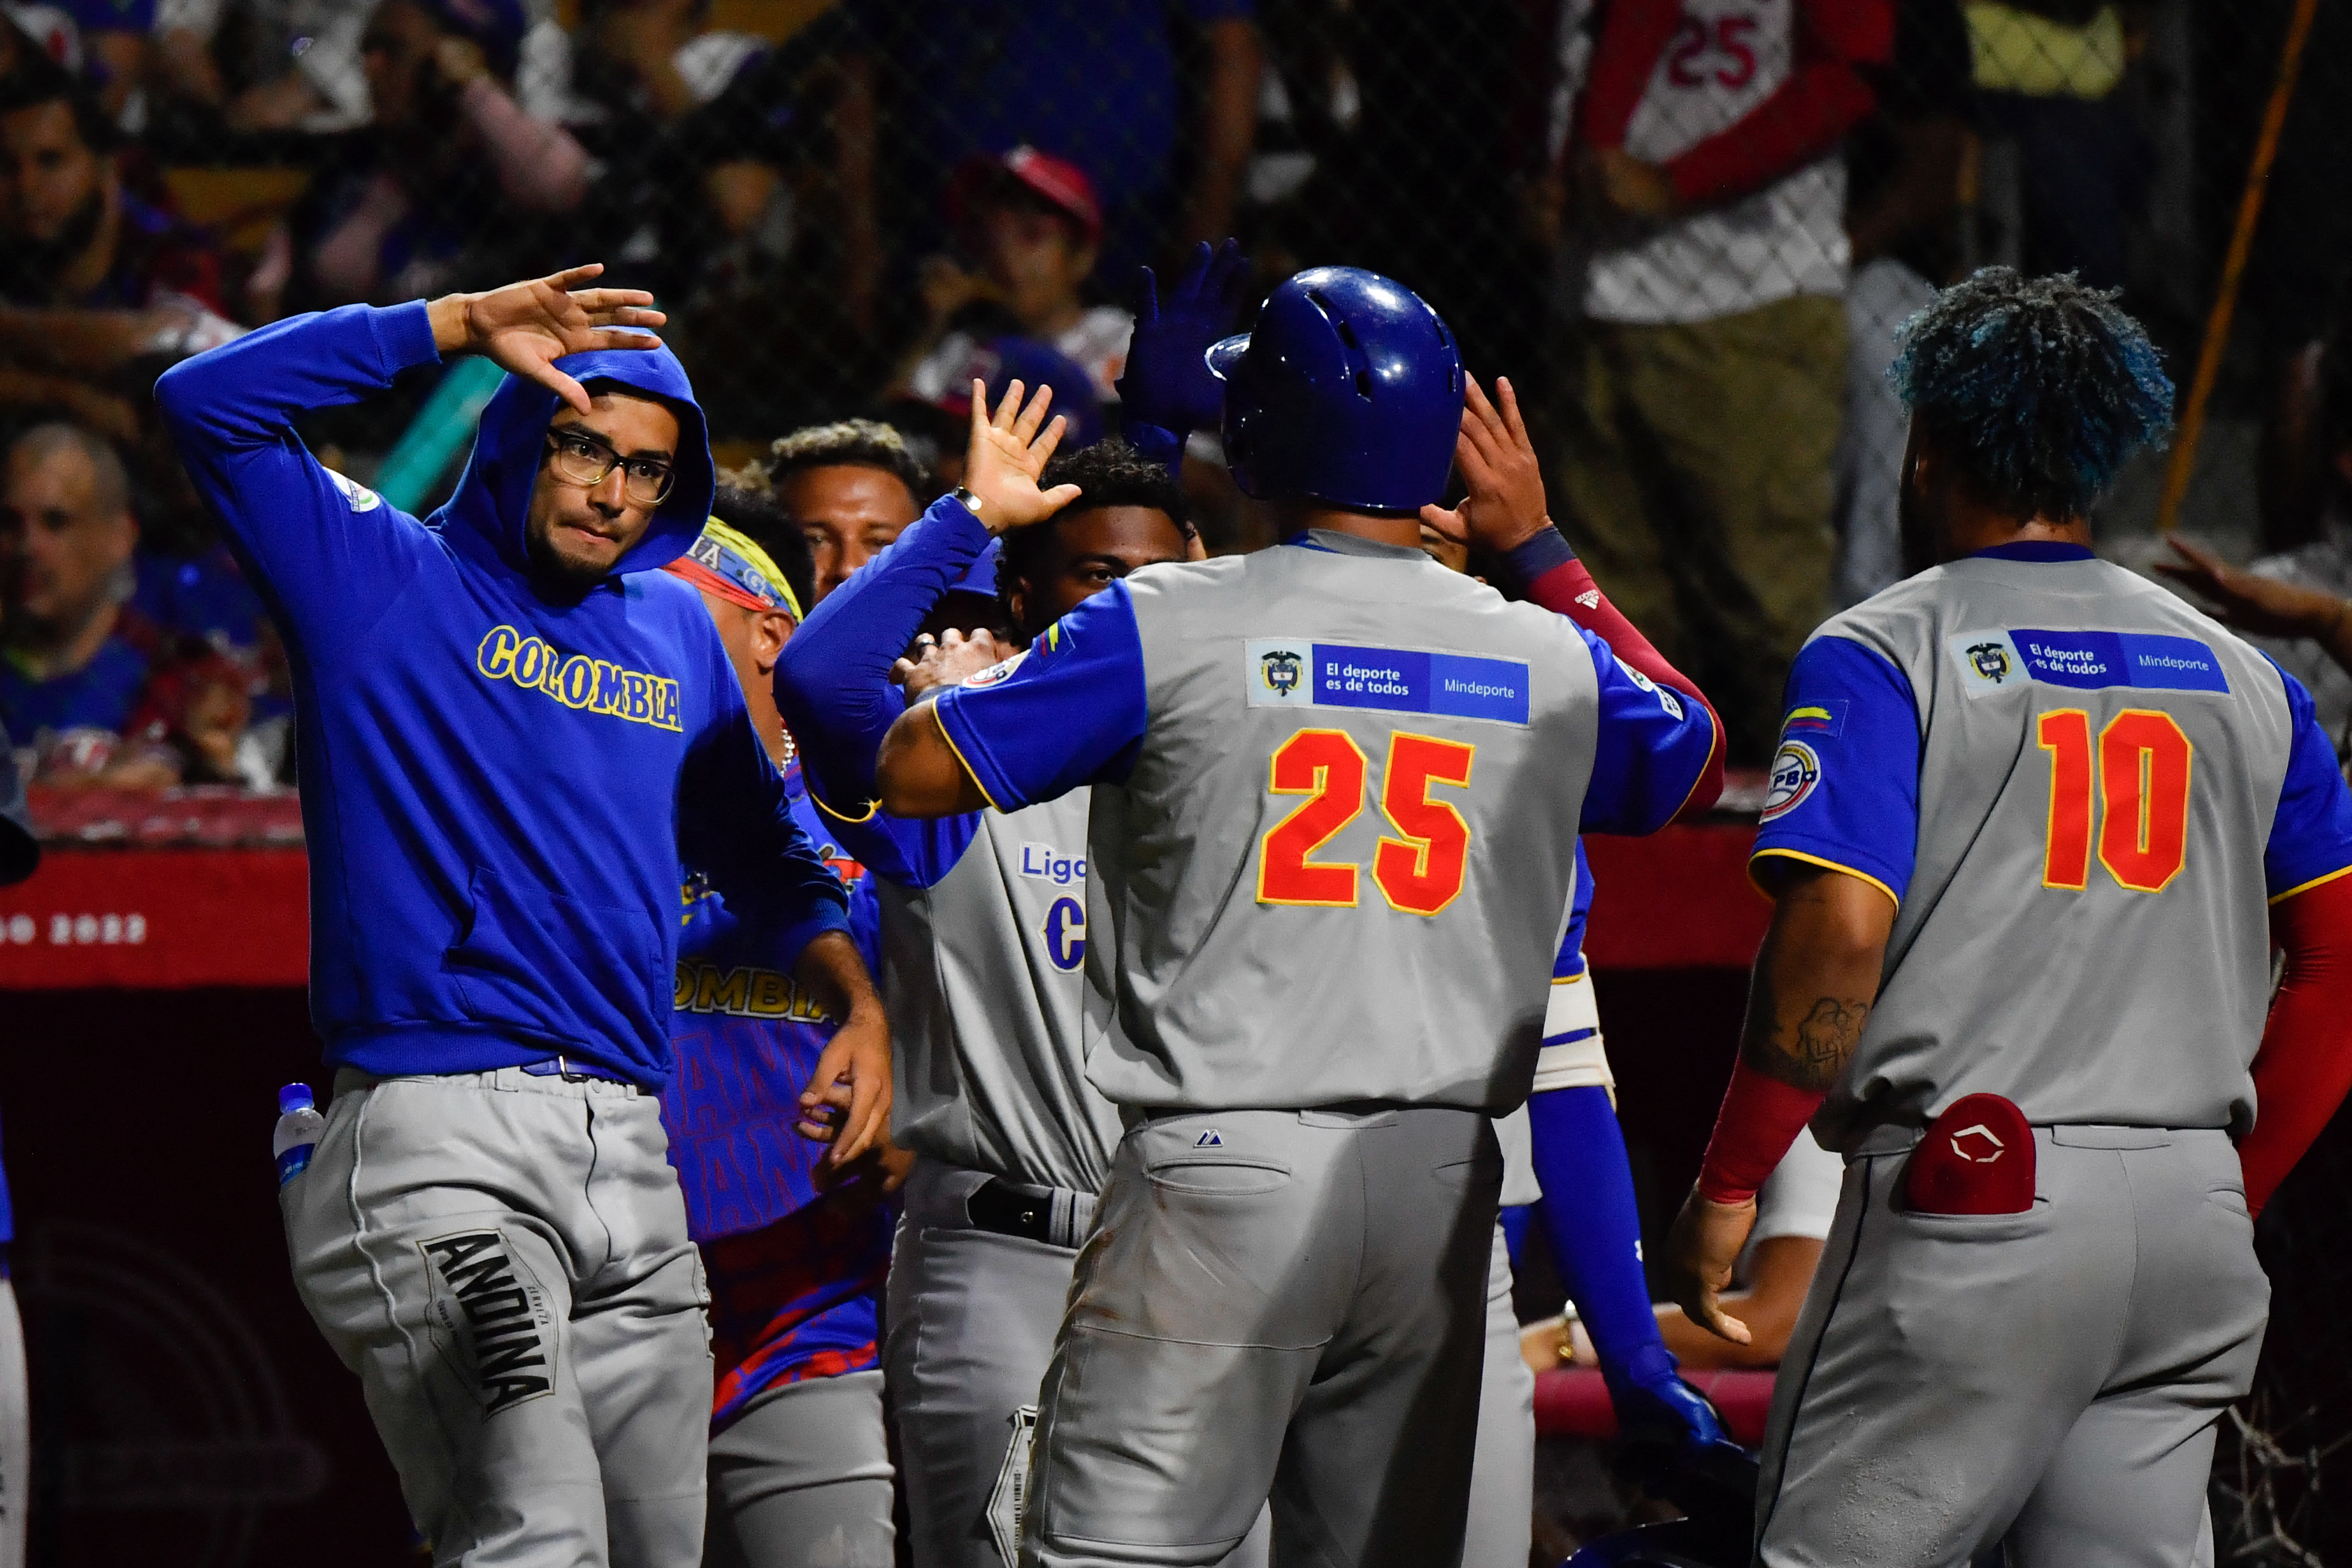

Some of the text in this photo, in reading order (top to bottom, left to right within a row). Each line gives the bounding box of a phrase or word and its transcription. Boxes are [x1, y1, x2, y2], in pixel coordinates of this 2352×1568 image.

[1668, 14, 1756, 86] 25
[2030, 643, 2094, 662] El deporte
[2139, 654, 2210, 671] Mindeporte
[1326, 662, 1400, 682] El deporte
[2036, 658, 2106, 675] es de todos
[477, 625, 683, 733] COLOMBIA
[1326, 678, 1409, 695] es de todos
[1445, 678, 1515, 699] Mindeporte
[2037, 707, 2193, 894] 10
[1256, 727, 1476, 917] 25
[424, 1233, 550, 1414] ANDINA
